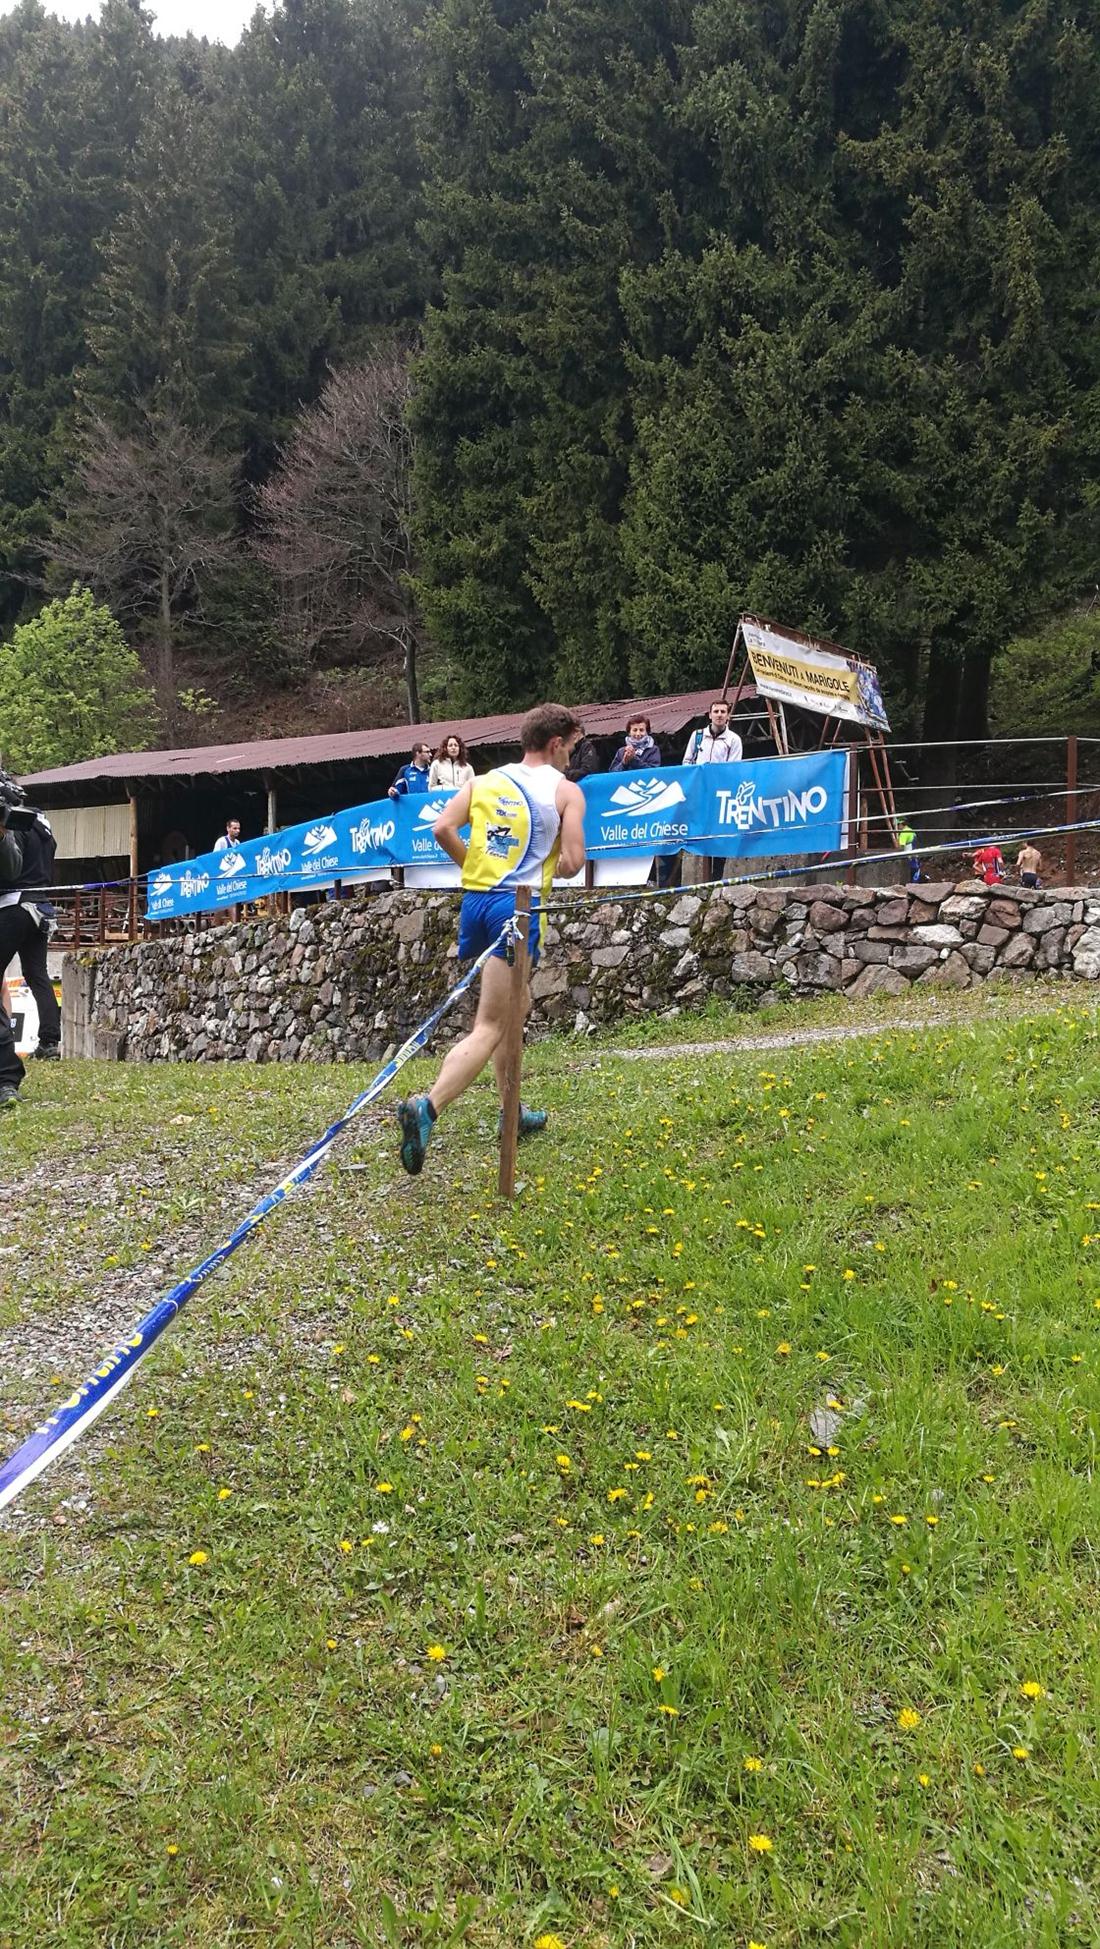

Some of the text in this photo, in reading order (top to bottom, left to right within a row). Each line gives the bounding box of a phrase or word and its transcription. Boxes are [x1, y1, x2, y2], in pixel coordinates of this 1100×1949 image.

[751, 650, 799, 680] BENVENUTI
[716, 785, 828, 830] TRENTINO
[600, 821, 688, 841] Valle del Chiese
[411, 838, 433, 852] Valle
